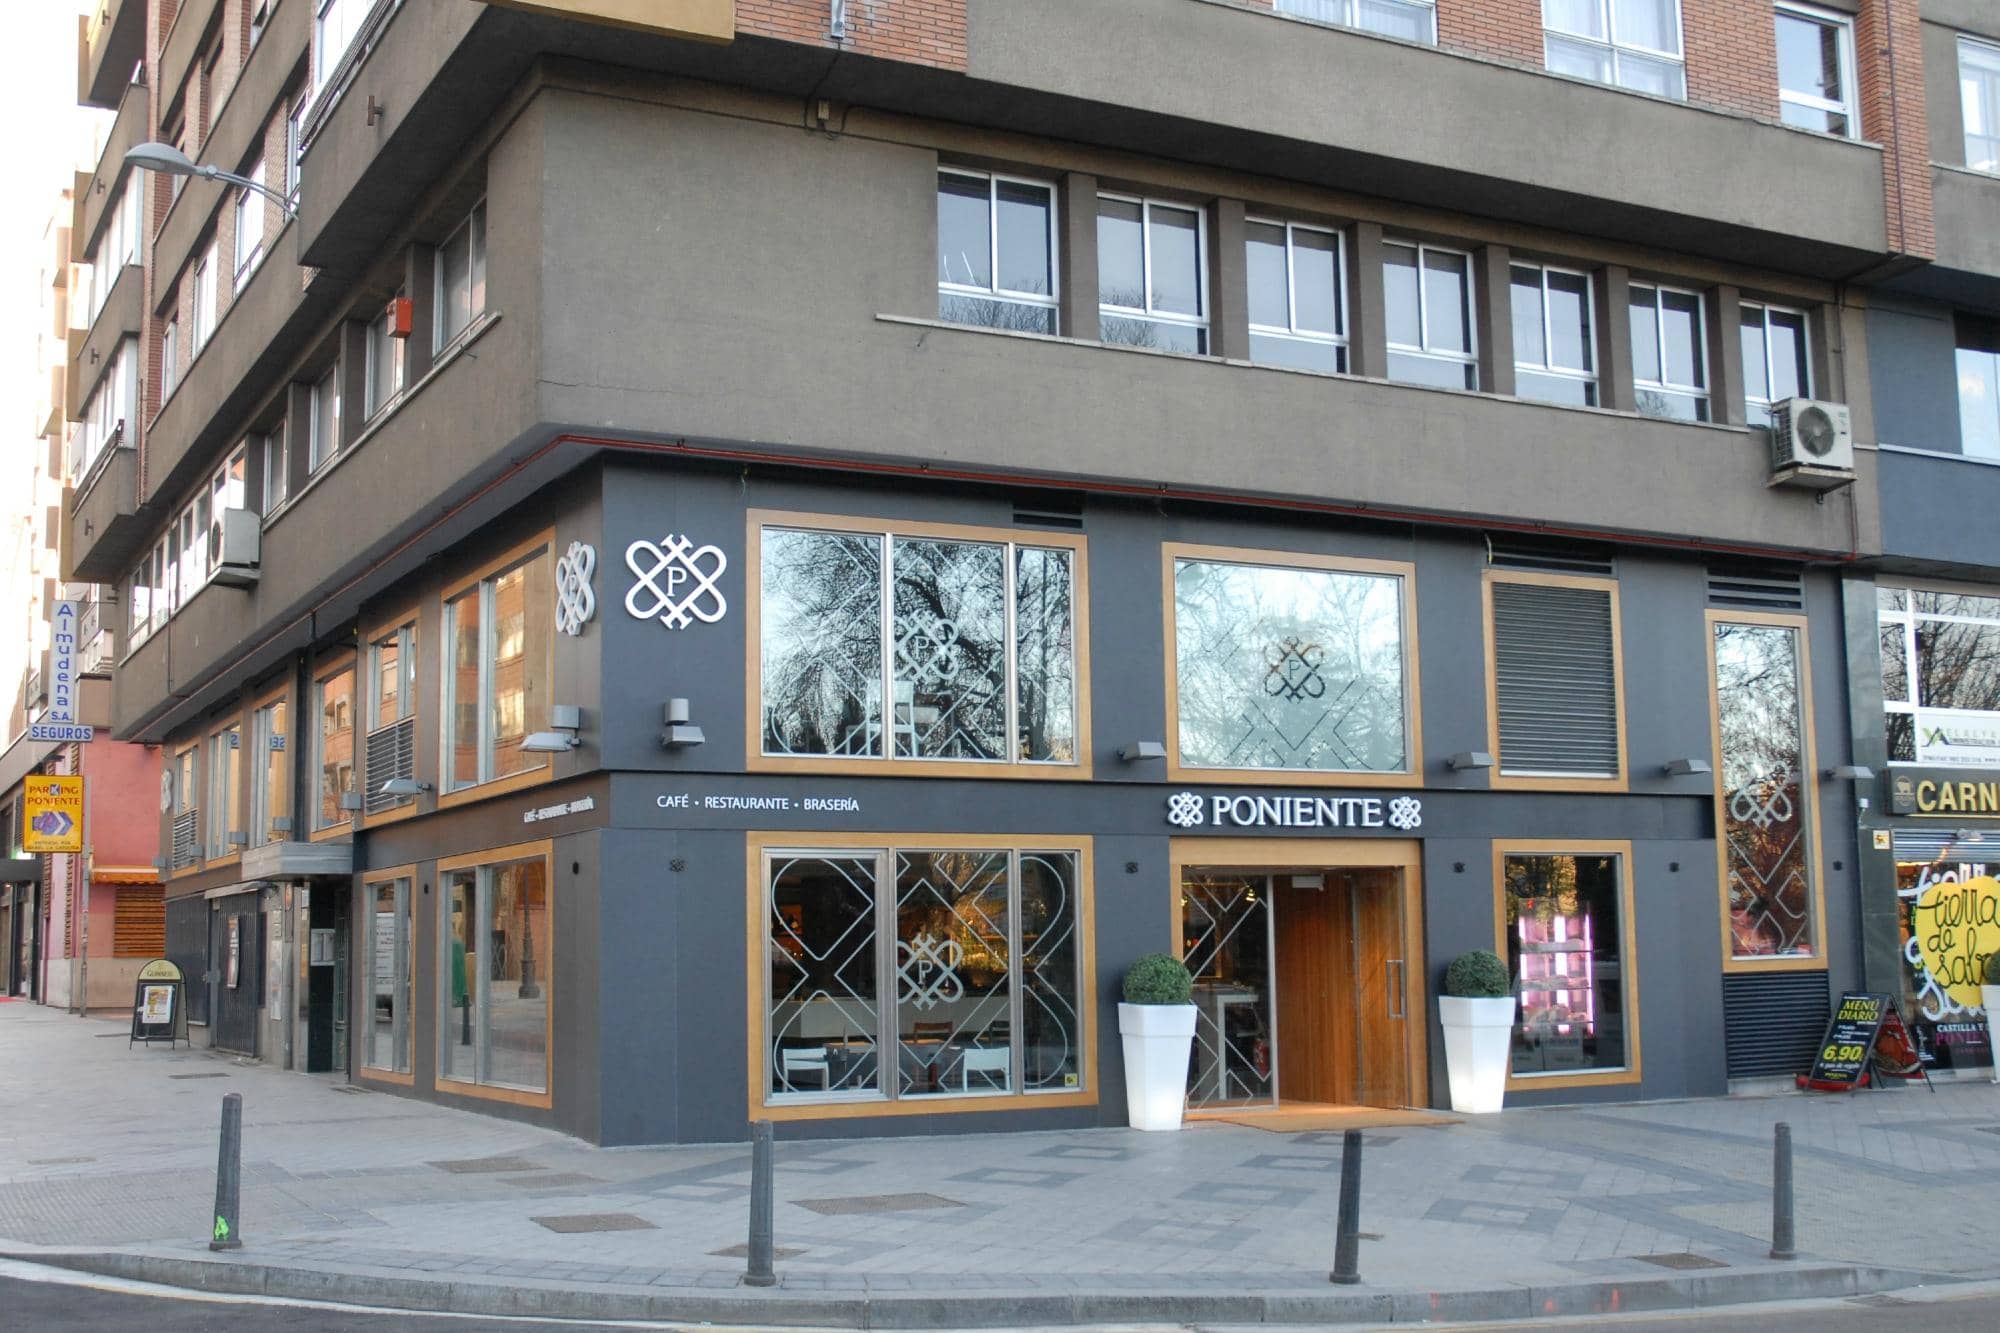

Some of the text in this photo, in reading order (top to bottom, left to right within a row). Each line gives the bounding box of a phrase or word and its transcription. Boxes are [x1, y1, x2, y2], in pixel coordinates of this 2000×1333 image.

[667, 566, 687, 597] P
[55, 604, 73, 706] Almudena
[51, 711, 73, 721] S.A.
[31, 726, 91, 739] SEGUROS
[29, 784, 79, 796] PARKING
[1917, 780, 2000, 812] CARN
[28, 797, 80, 805] PONIENTE
[656, 794, 859, 811] CAFÉ RESTAURANTE BRASERÍA
[1211, 796, 1384, 827] PONIENTE
[1918, 889, 2000, 927] tierra
[1927, 928, 1956, 953] de
[1837, 1010, 1879, 1020] DIARIO
[1936, 1023, 1976, 1032] CASTILLA
